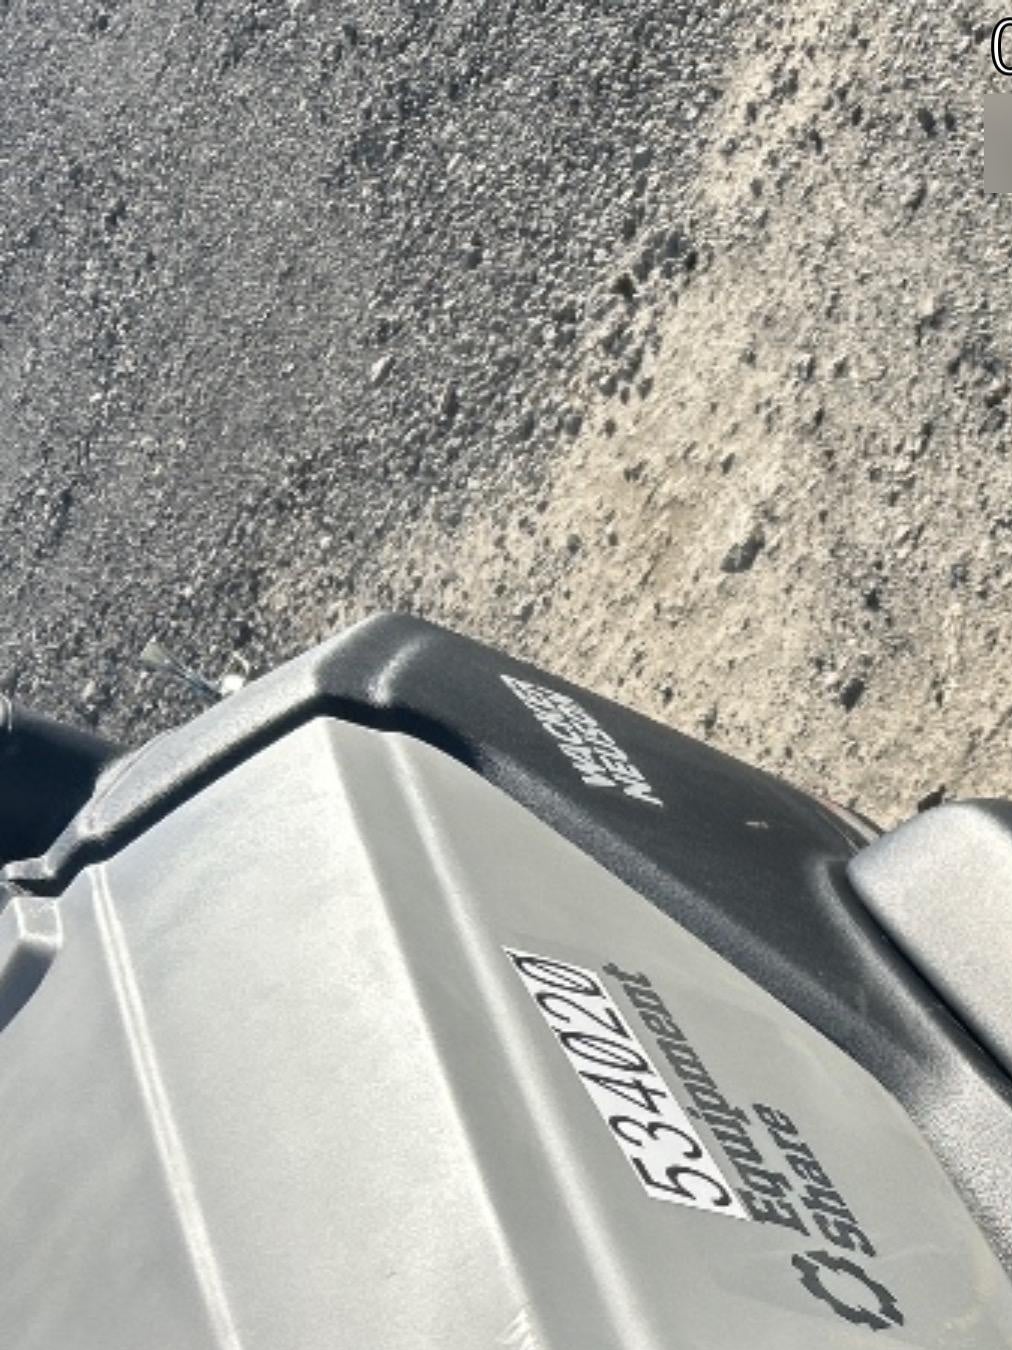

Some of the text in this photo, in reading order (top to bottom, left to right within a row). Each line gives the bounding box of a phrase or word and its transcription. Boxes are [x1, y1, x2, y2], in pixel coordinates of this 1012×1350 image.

[508, 950, 733, 1206] 534020
[602, 962, 811, 1237] Equipment
[753, 1103, 877, 1258] Share
